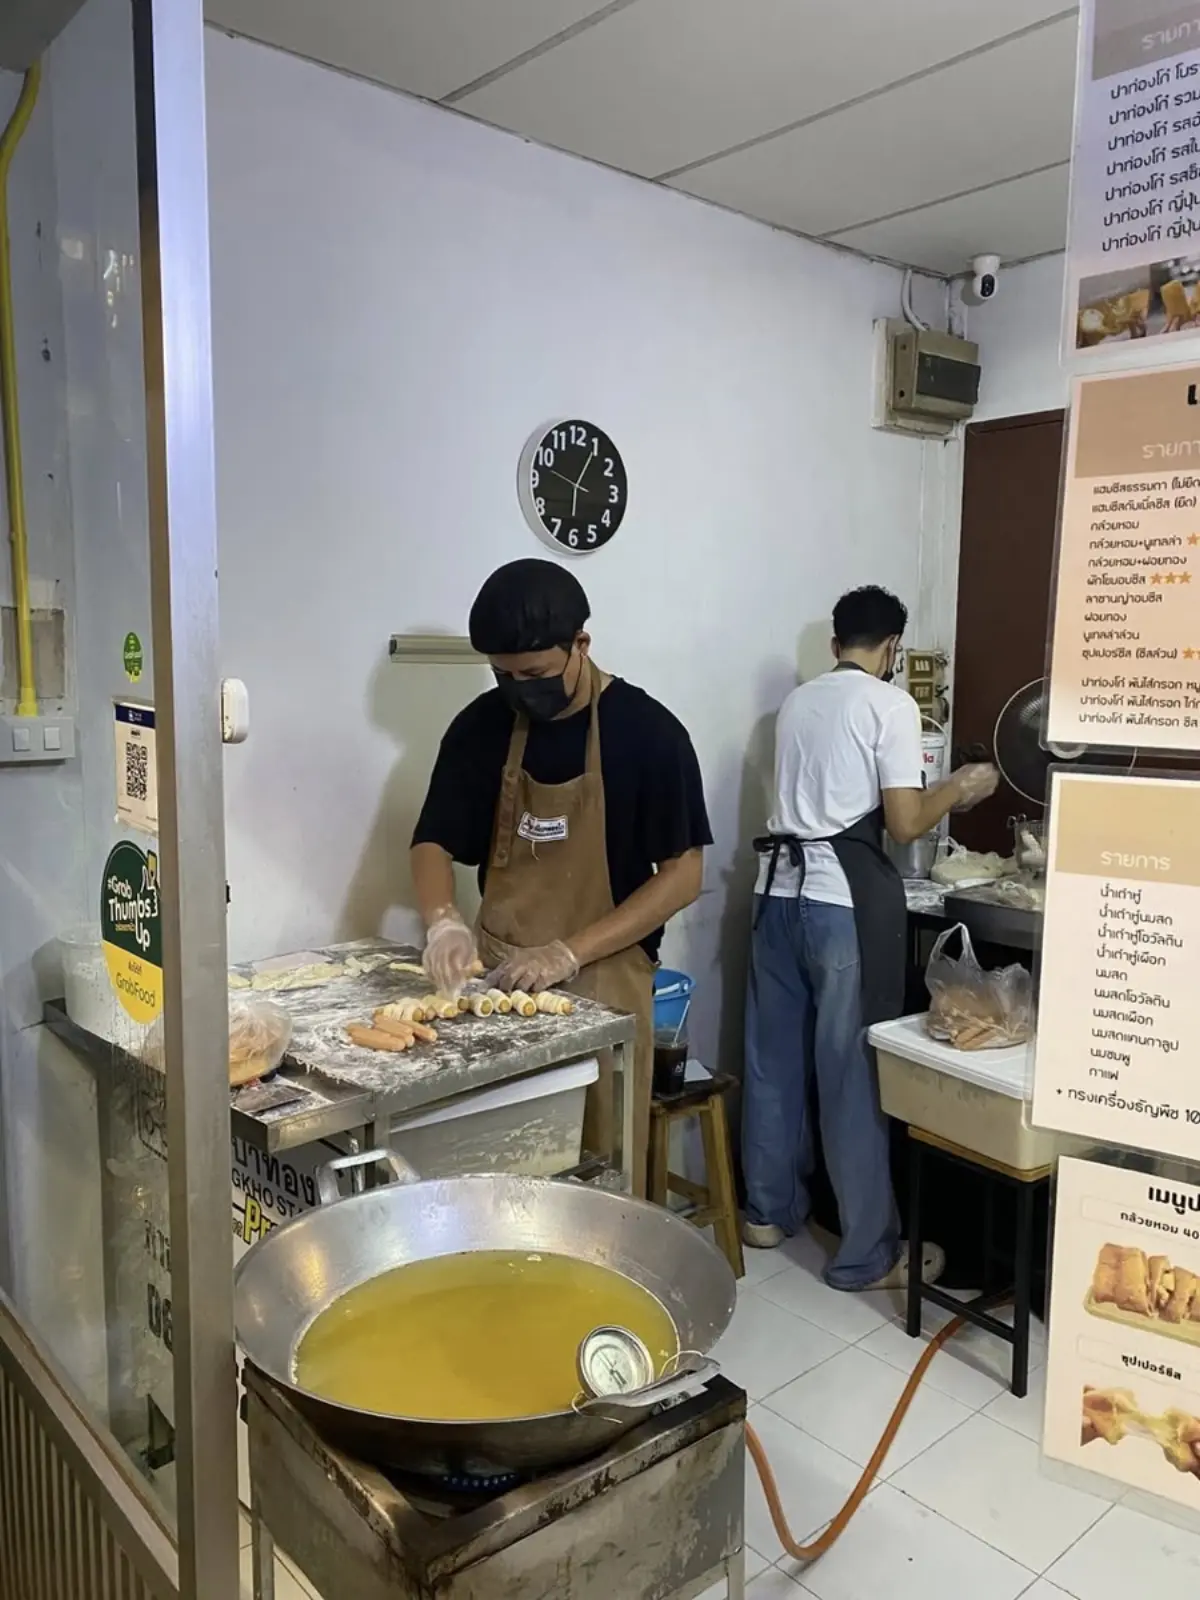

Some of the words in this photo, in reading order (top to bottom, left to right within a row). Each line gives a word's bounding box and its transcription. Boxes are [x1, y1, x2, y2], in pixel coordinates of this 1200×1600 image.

[552, 429, 566, 451] 11
[569, 425, 587, 447] 12
[591, 437, 598, 456] 1
[538, 446, 554, 467] 10
[604, 458, 614, 477] 2
[532, 469, 539, 488] 9
[608, 485, 618, 503] 3
[535, 497, 545, 516] 8
[551, 517, 562, 536] 7
[601, 509, 611, 527] 4
[1090, 520, 1140, 531] กล้วยหอม
[568, 528, 578, 546] 6
[587, 524, 597, 542] 5
[1101, 850, 1171, 871] รายการ
[108, 893, 151, 922] Thumbs
[135, 920, 151, 952] Up
[1095, 968, 1128, 981] นมสด
[116, 972, 156, 1008] GrabFood
[1090, 1047, 1131, 1067] นมชมพู
[1088, 1067, 1119, 1080] กาแฟ
[277, 1195, 303, 1218] ST
[1120, 1212, 1179, 1234] กล้วยหอม
[1183, 1228, 1200, 1240] 40
